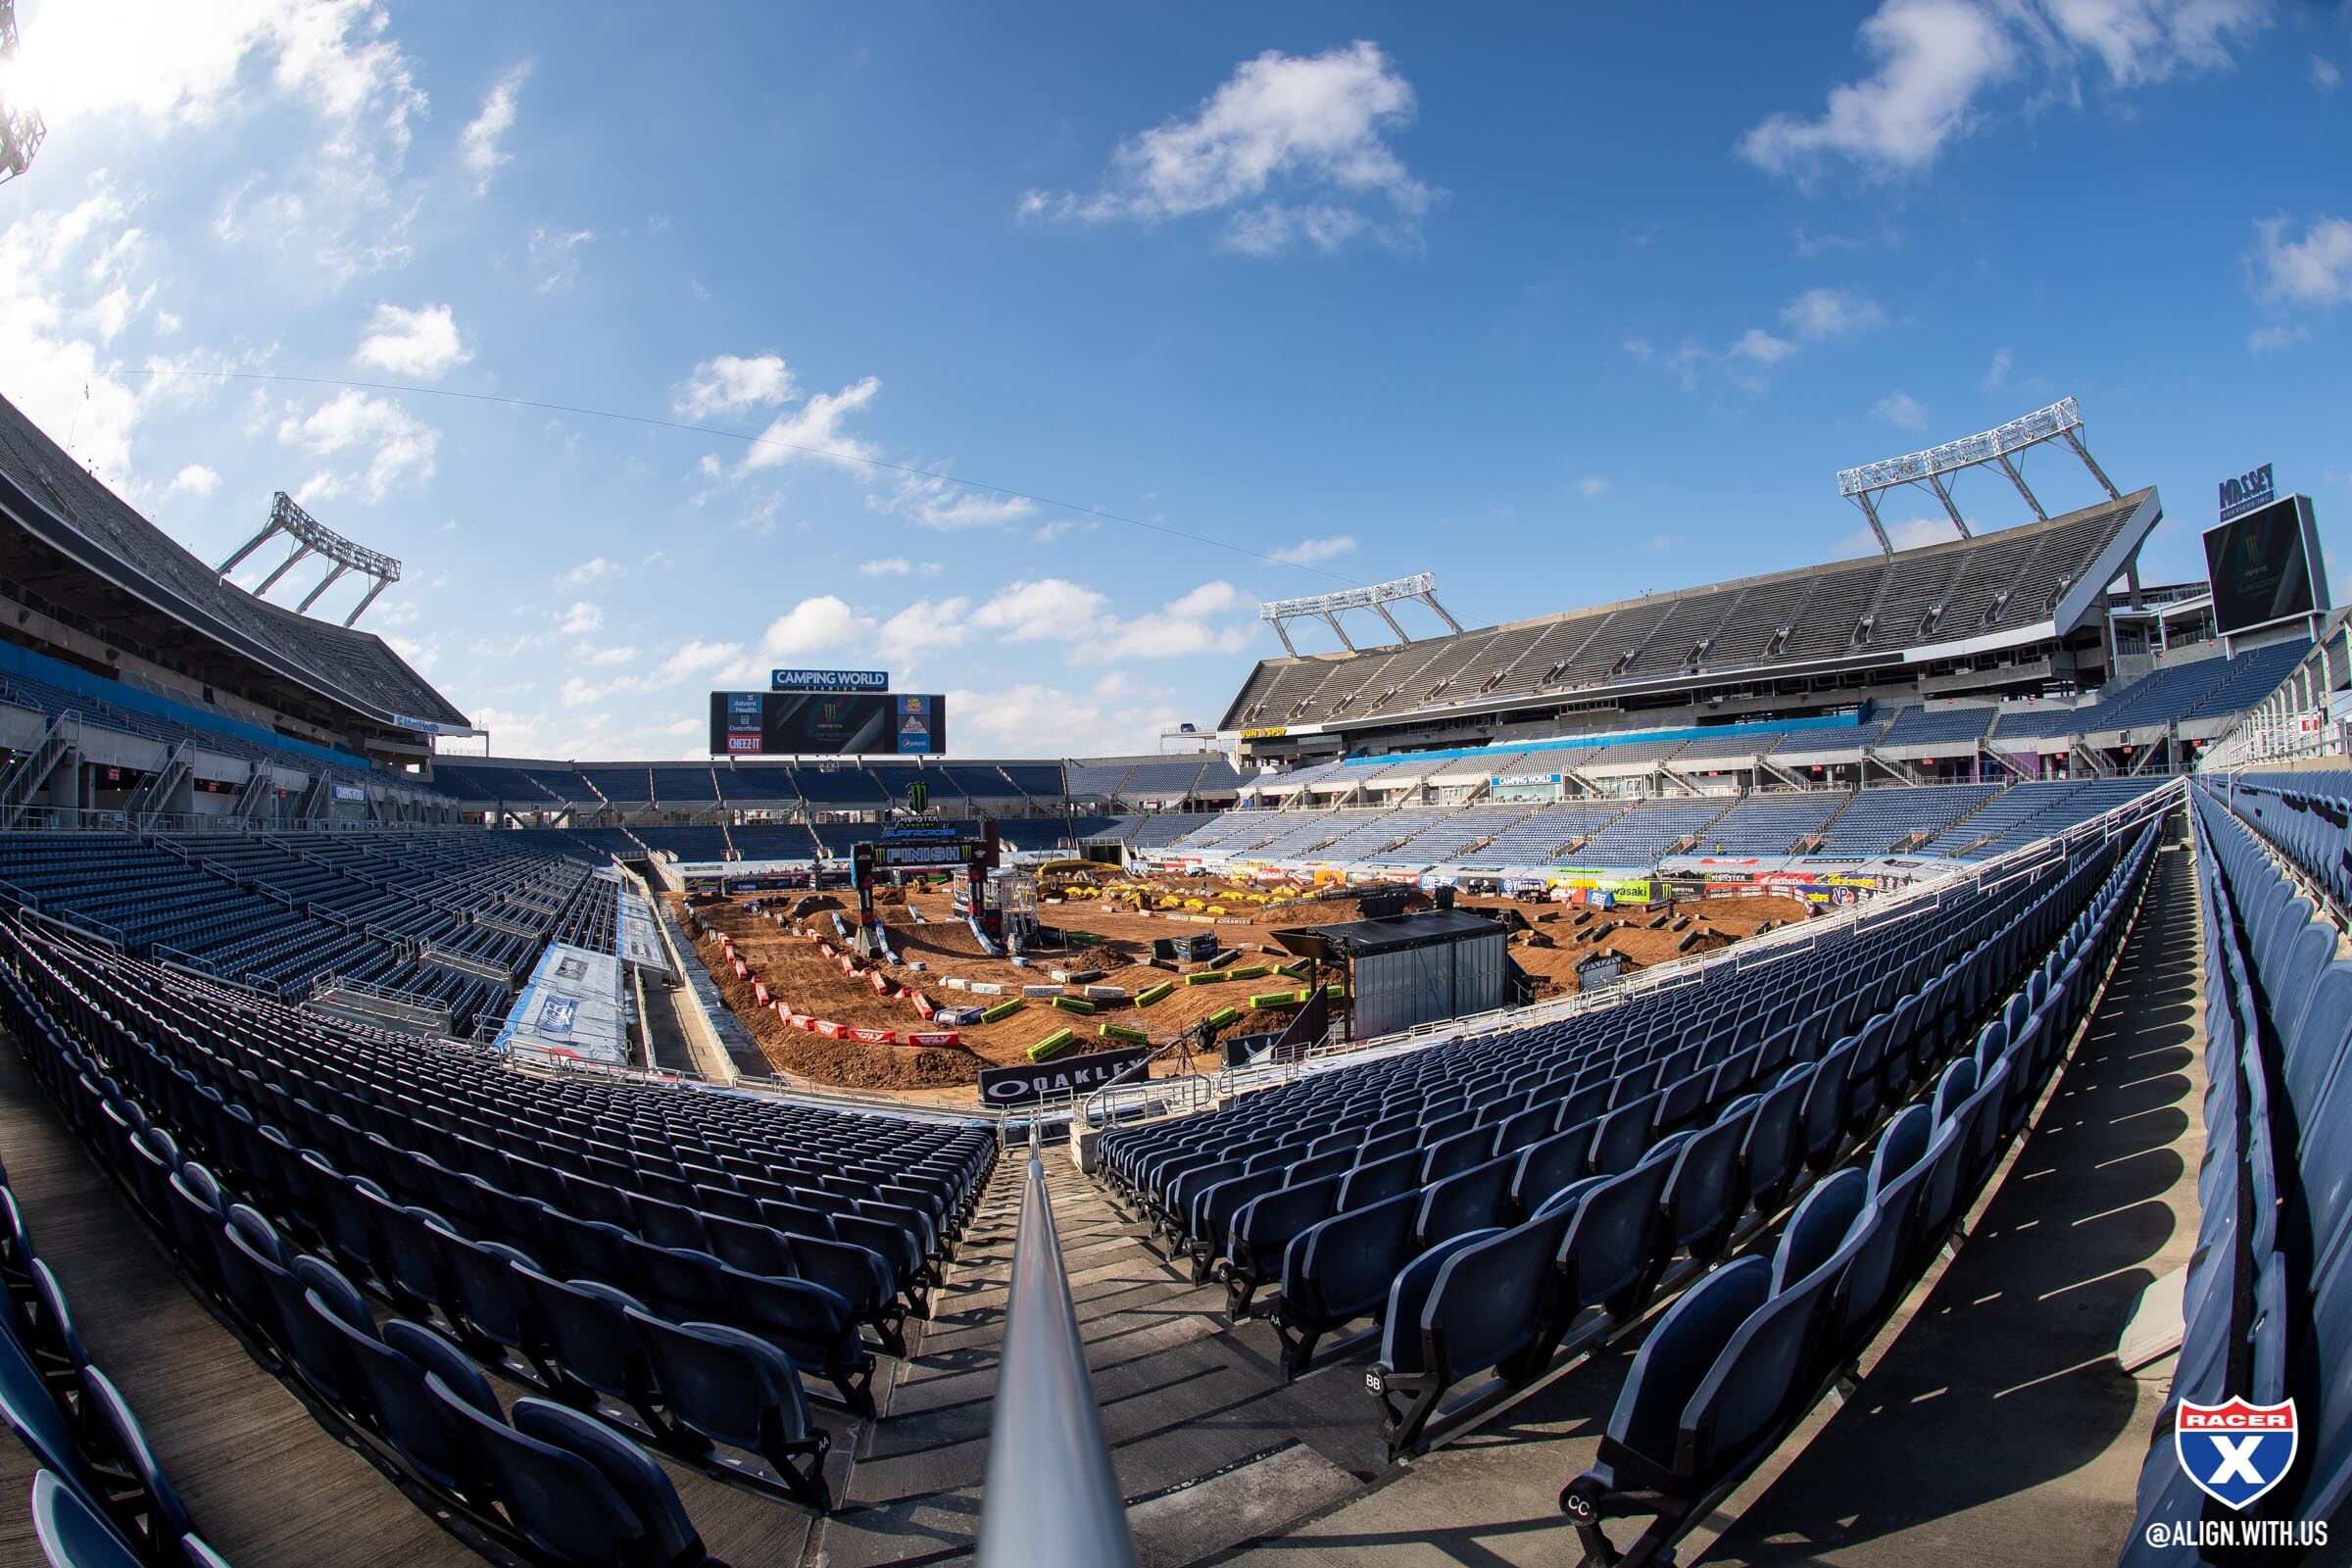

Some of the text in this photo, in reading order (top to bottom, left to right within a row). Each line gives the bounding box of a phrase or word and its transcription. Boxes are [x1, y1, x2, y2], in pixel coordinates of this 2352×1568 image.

[2219, 463, 2274, 510] MASSEY
[776, 670, 885, 685] CAMPING WORLD
[1241, 727, 1287, 738] FUN SPOT
[1498, 774, 1552, 785] CAMPING WORLD
[900, 814, 939, 823] MONSTER
[886, 846, 960, 863] FINISH
[1711, 873, 1746, 882] MONSTER
[1257, 996, 1293, 1006] Kawasaki
[1106, 1028, 1146, 1042] Kawasaki
[1035, 1035, 1073, 1059] Kawasaki
[1033, 1057, 1145, 1093] OAKLEY
[1270, 1314, 1281, 1327] AA
[1365, 1373, 1381, 1391] BB
[818, 1435, 830, 1452] AA
[1567, 1494, 1591, 1516] CC
